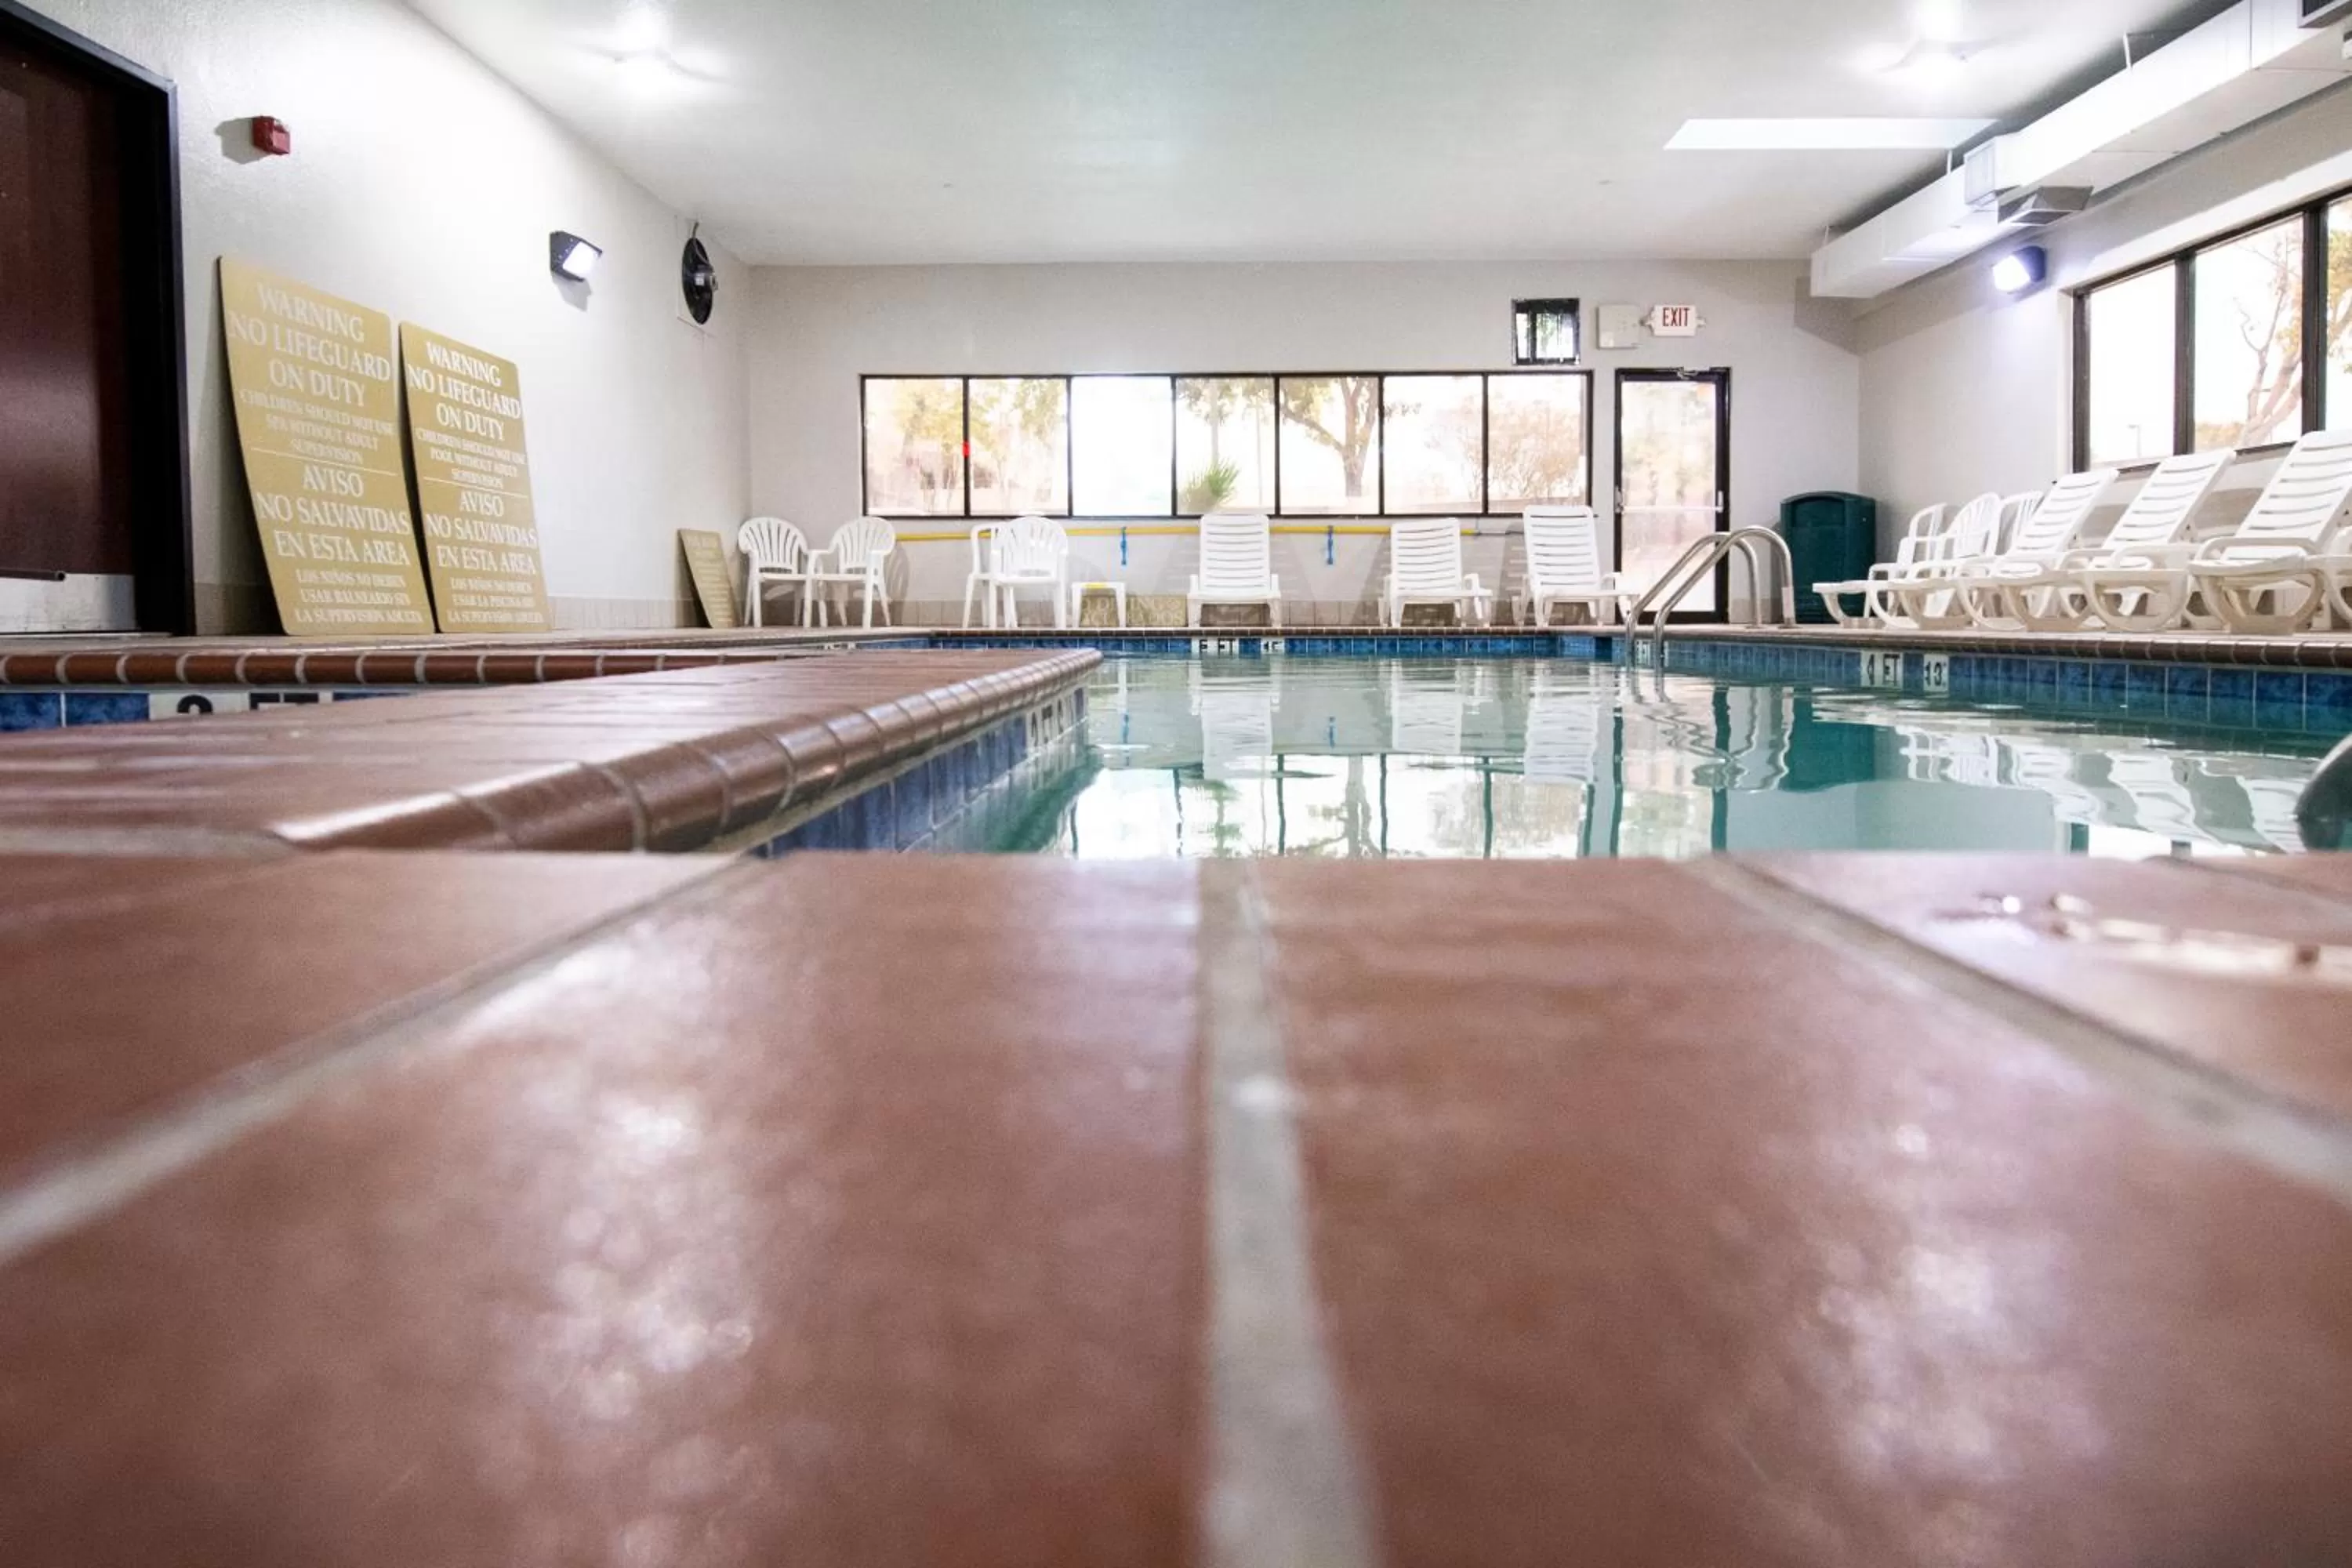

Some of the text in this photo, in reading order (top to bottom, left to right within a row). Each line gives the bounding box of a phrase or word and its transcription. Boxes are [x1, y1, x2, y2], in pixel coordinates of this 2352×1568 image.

[257, 281, 365, 343] WARNING
[1663, 307, 1690, 326] EXIT
[228, 310, 390, 380] NO LIFEGUARD
[426, 342, 501, 387] WARNING
[269, 358, 365, 408] ON DUTY
[408, 364, 521, 419] NO LIFEGUARD
[436, 403, 505, 441] ON DUTY
[303, 465, 364, 498] AVISO
[257, 492, 411, 535] NO SALVAVIDAS
[459, 491, 504, 517] AVISO
[274, 530, 411, 565] EN ESTA AREA
[426, 514, 537, 549] NO SALVAVIDAS
[437, 546, 536, 574] EN ESTA AREA
[1096, 597, 1164, 610] DIING
